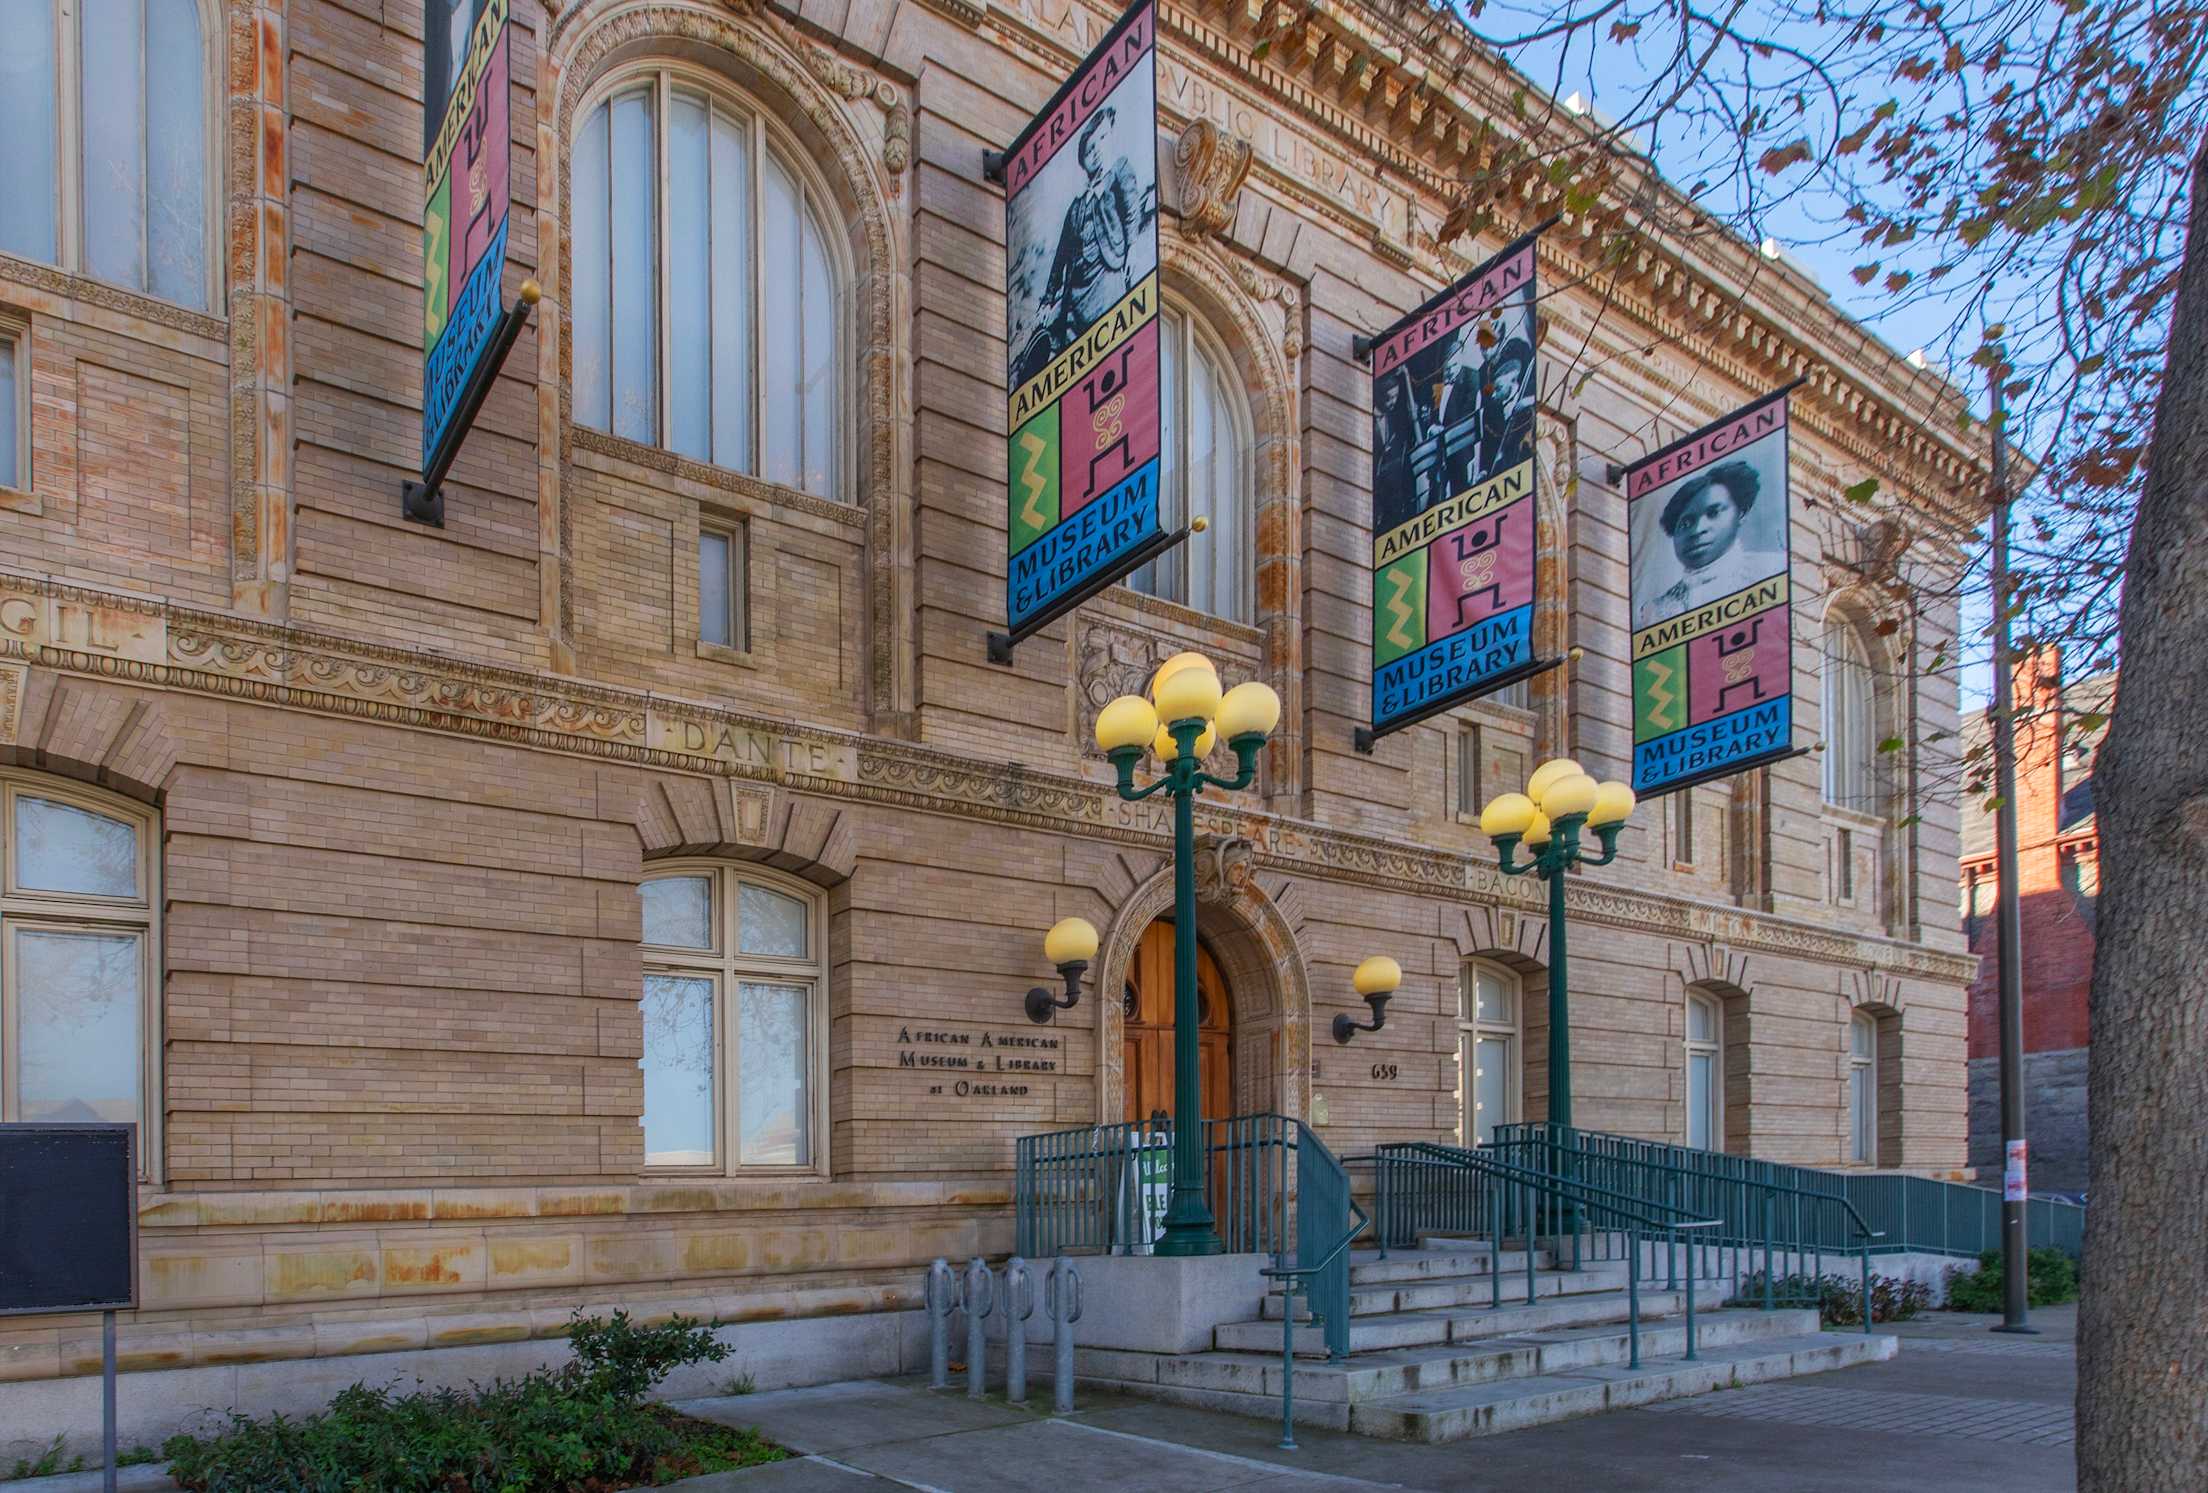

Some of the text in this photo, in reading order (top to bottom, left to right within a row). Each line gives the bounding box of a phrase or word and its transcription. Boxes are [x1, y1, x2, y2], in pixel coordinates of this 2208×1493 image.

[426, 1, 501, 187] AMERICAN
[1014, 22, 1144, 187] AFRICAN
[1382, 258, 1523, 370] AFRICAN
[1015, 286, 1148, 423] AMERICAN
[1637, 407, 1776, 492] AFRICAN
[1016, 473, 1147, 585] MUSEUM
[1381, 470, 1522, 560] AMERICAN
[0, 597, 120, 652] GIL
[1382, 615, 1519, 692] MUSEUM
[1639, 582, 1778, 653] AMERICAN
[684, 721, 826, 774] DANTE
[1642, 703, 1779, 764] MUSEUM
[1118, 801, 1296, 857] SHAESPEARE
[1477, 870, 1547, 902] BACON
[975, 1060, 985, 1070] &
[1371, 1063, 1398, 1080] 659
